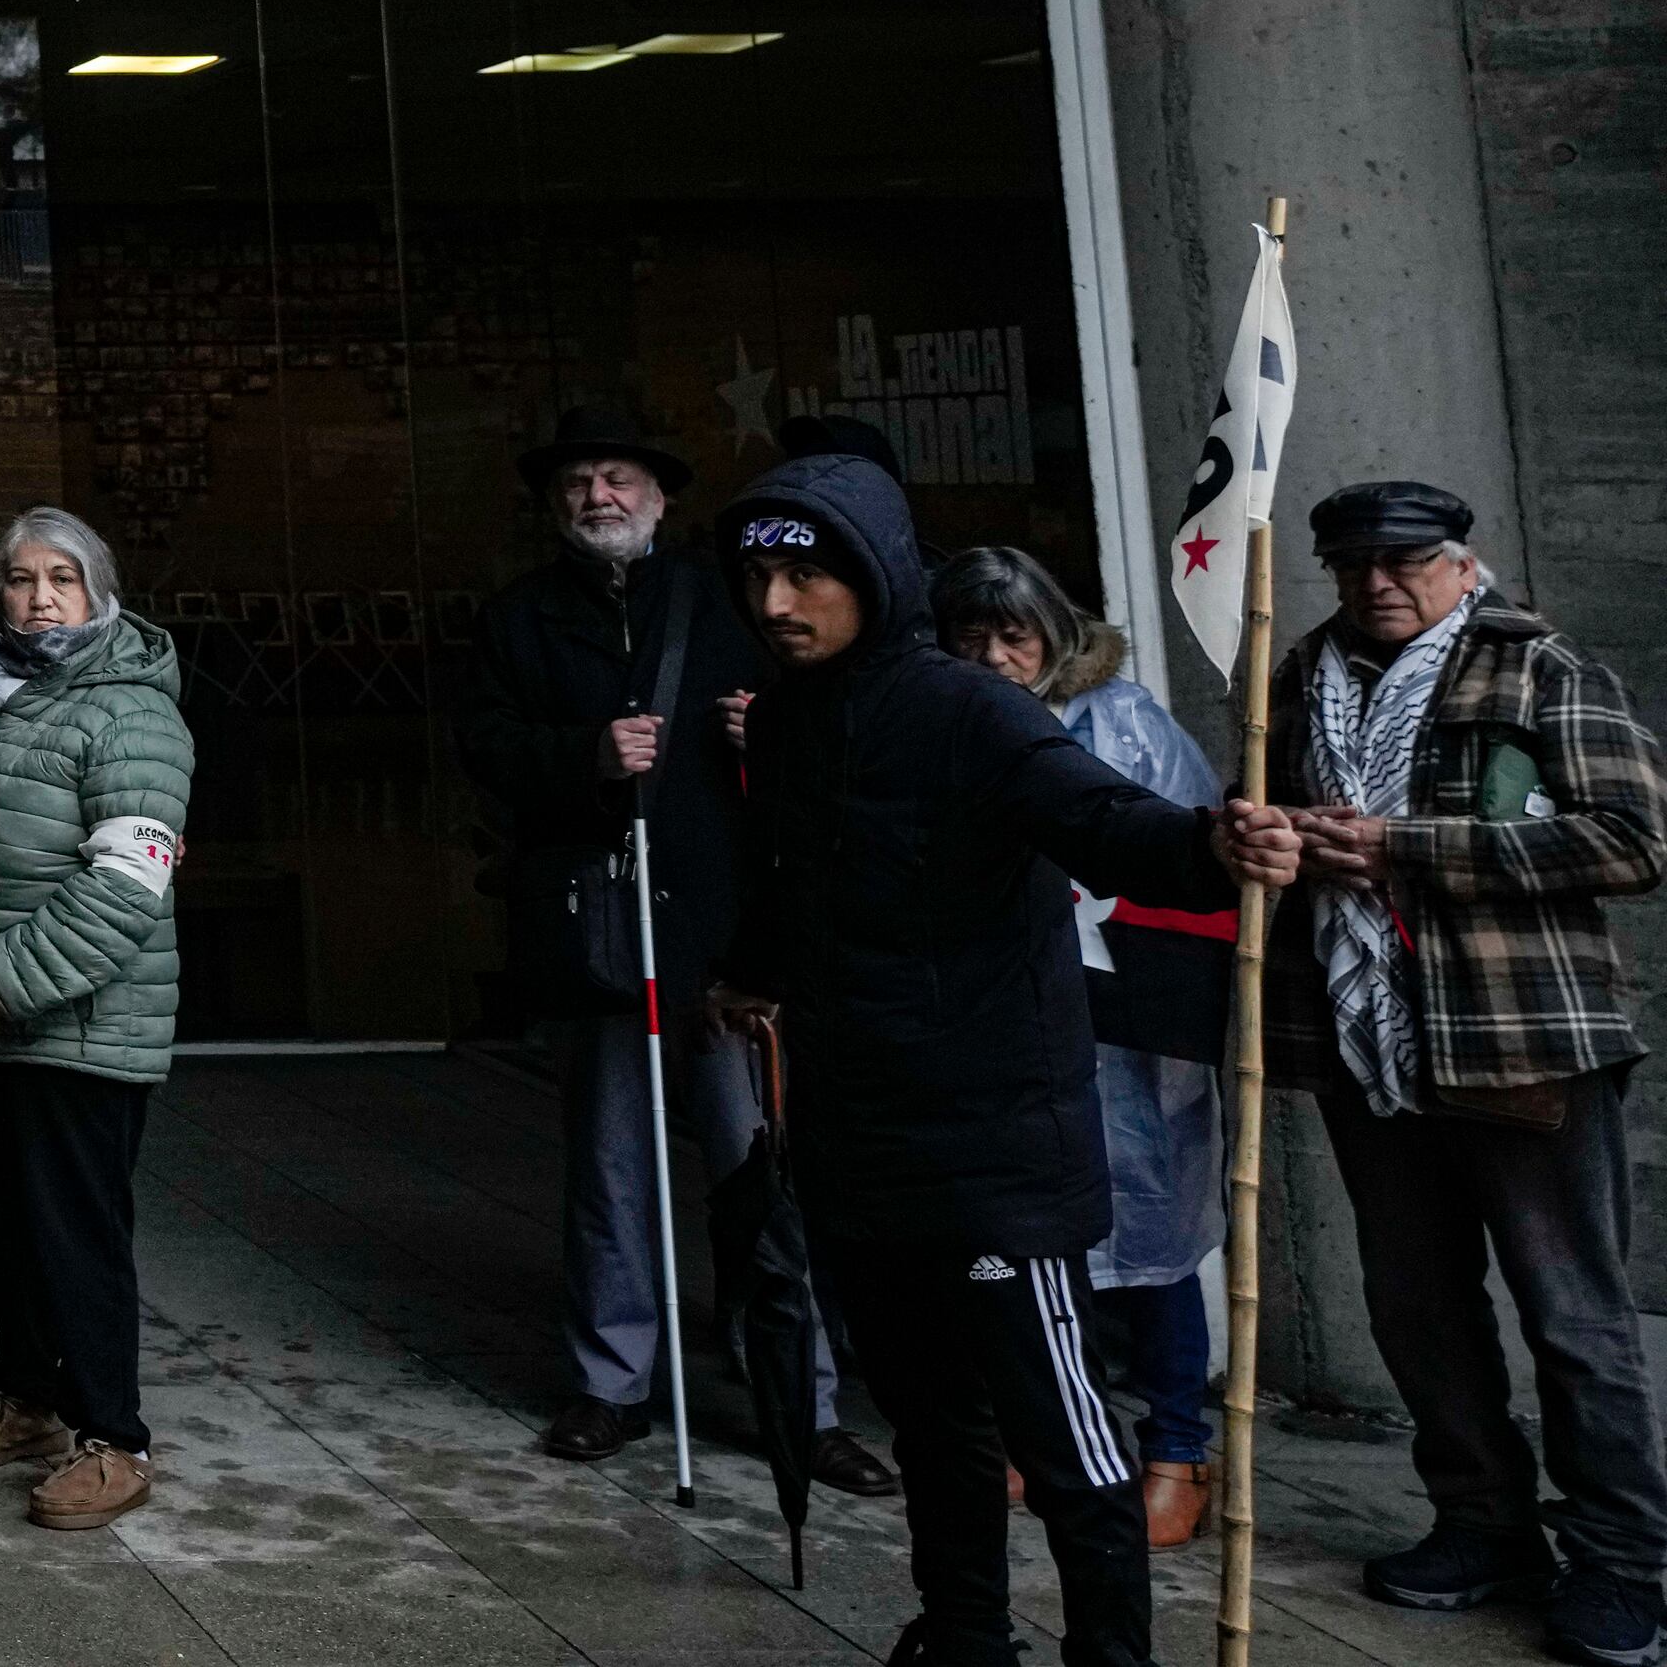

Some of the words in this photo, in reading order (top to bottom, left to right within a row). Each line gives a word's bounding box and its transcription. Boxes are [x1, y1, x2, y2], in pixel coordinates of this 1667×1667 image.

[783, 520, 816, 546] 25
[137, 826, 174, 847] ACOMPA
[969, 1267, 1017, 1281] adidas
